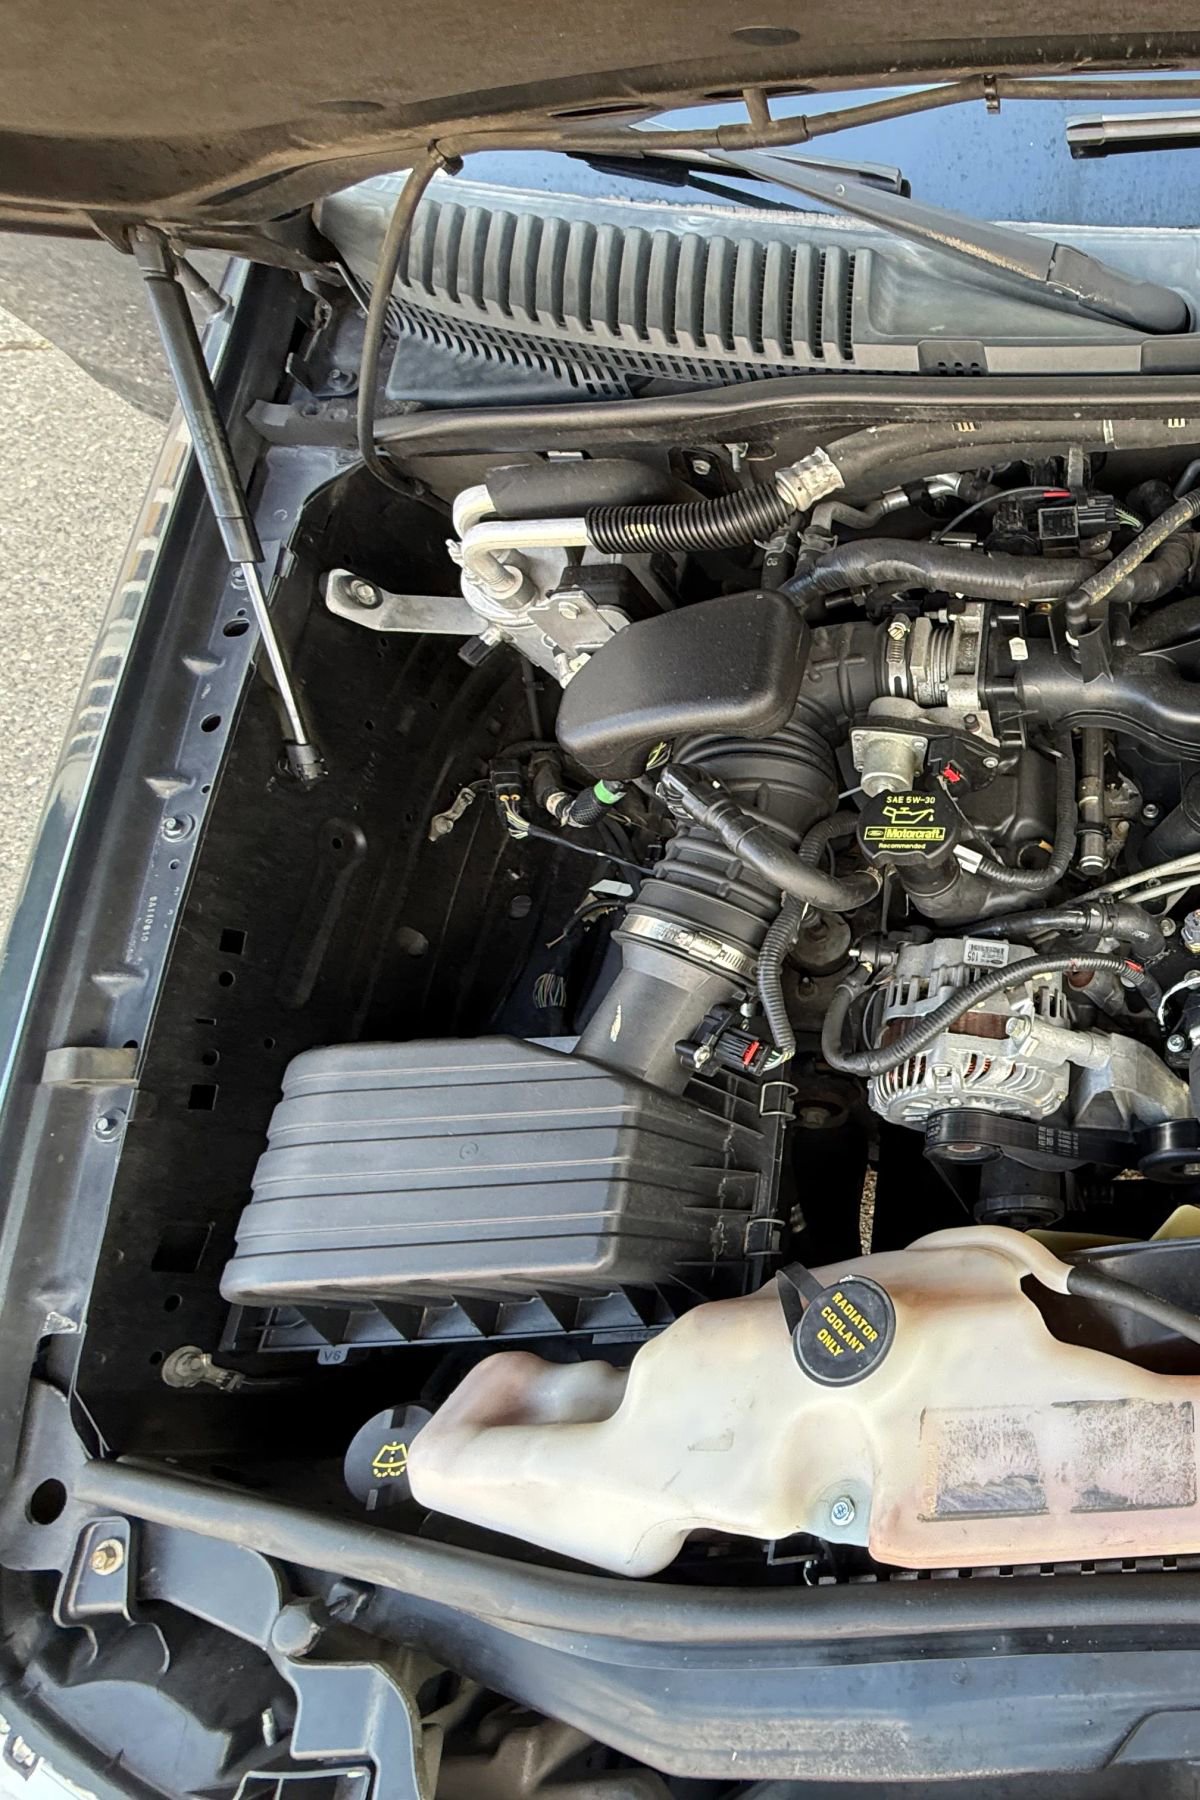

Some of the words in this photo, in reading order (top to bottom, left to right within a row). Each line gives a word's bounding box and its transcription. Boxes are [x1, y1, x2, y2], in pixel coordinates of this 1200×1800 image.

[886, 795, 904, 804] SAE
[906, 795, 936, 804] 5W-30
[821, 1305, 866, 1354] COOLANT
[832, 1291, 879, 1343] RADIATOR
[323, 1350, 342, 1362] V6
[817, 1328, 845, 1357] ONLY
